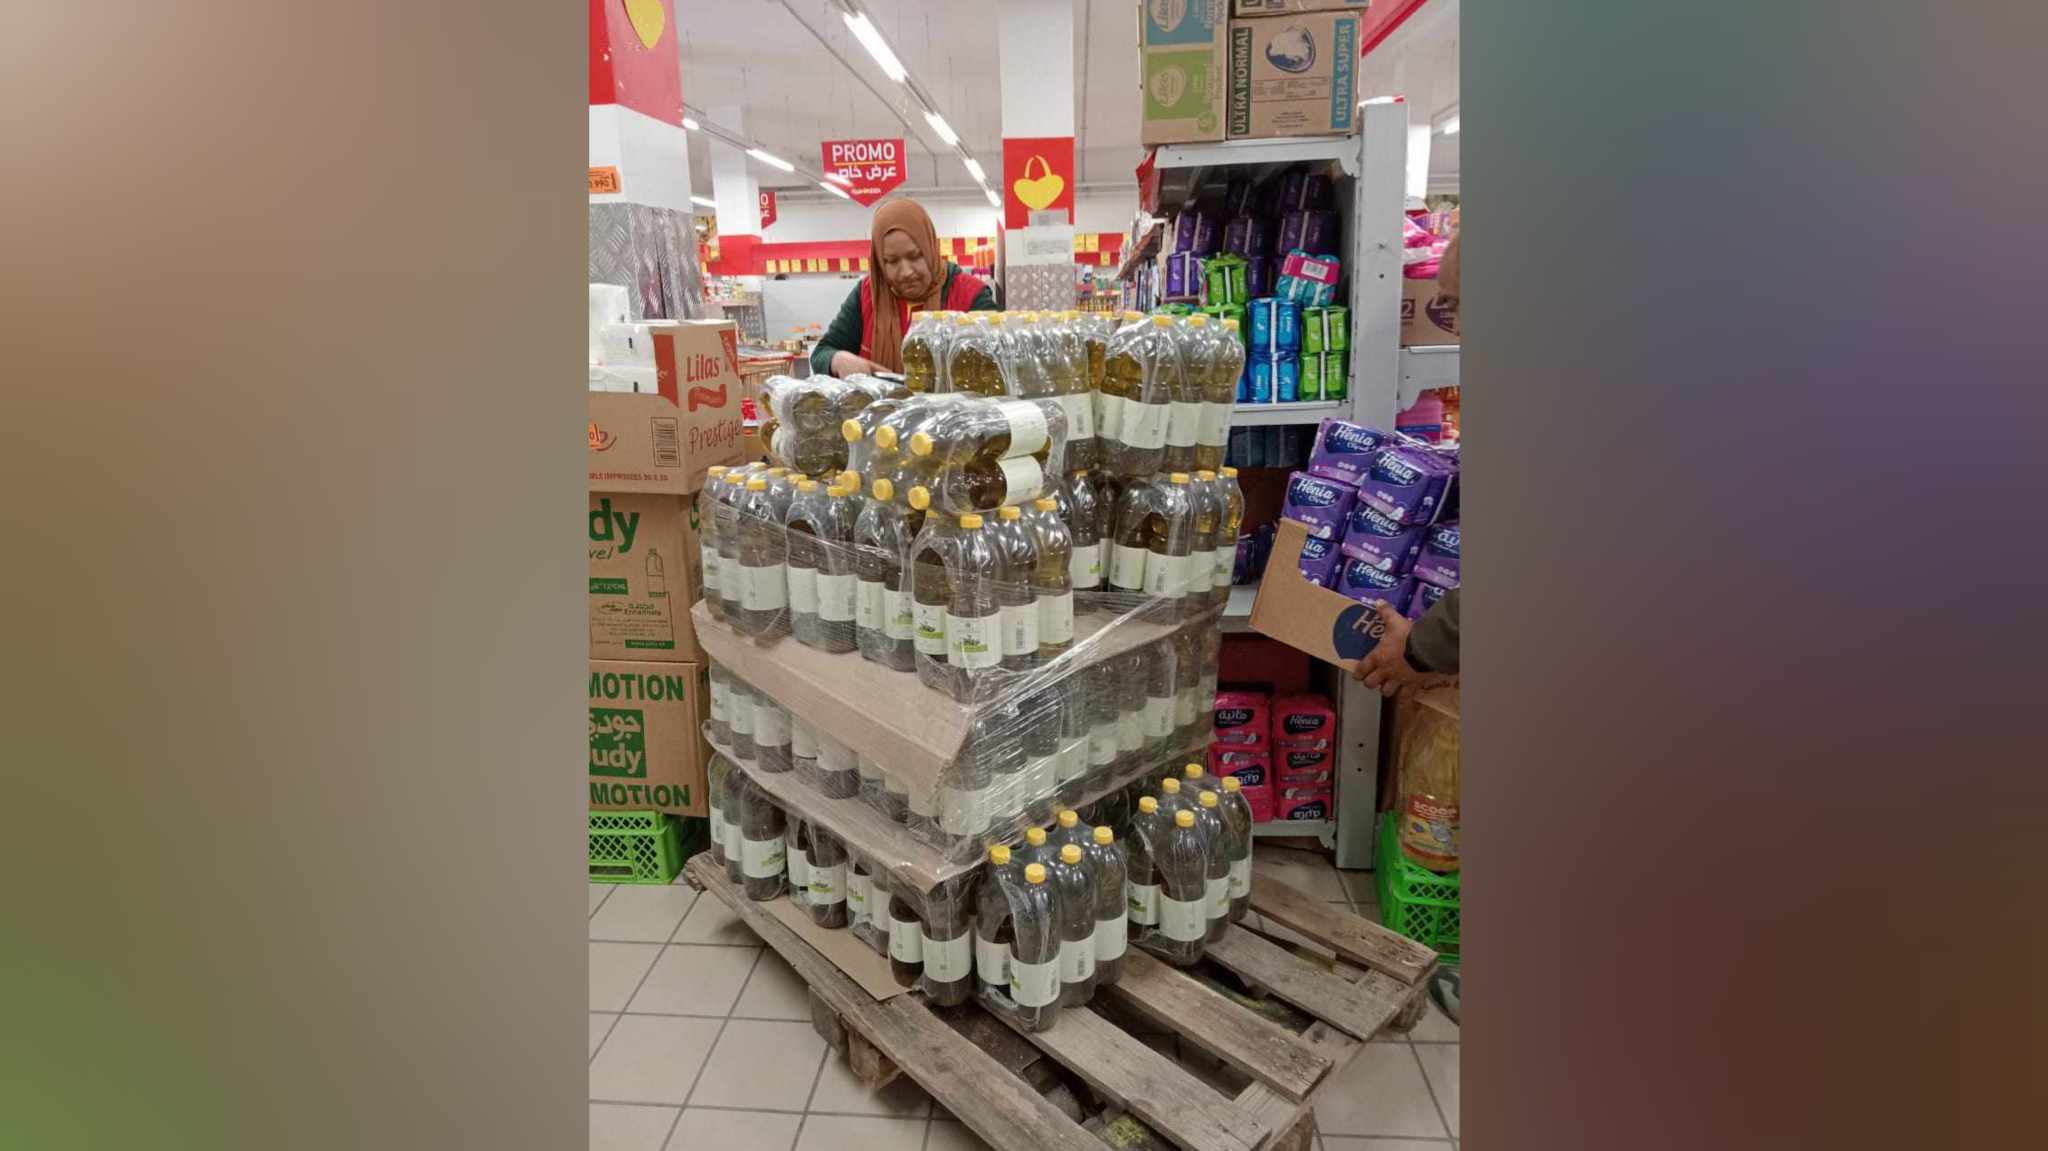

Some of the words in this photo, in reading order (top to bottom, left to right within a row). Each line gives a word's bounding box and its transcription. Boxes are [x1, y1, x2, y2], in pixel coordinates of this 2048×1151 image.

[1235, 28, 1249, 87] NORMAL
[1338, 24, 1352, 74] SUPER
[1233, 89, 1246, 133] ULTRA
[1336, 76, 1348, 121] ULTRA
[832, 143, 895, 162] PROMO
[866, 162, 897, 181] عرض
[686, 353, 719, 382] Lilas
[688, 419, 742, 456] Prestige
[1352, 610, 1384, 639] Hé
[589, 782, 691, 807] MOTION
